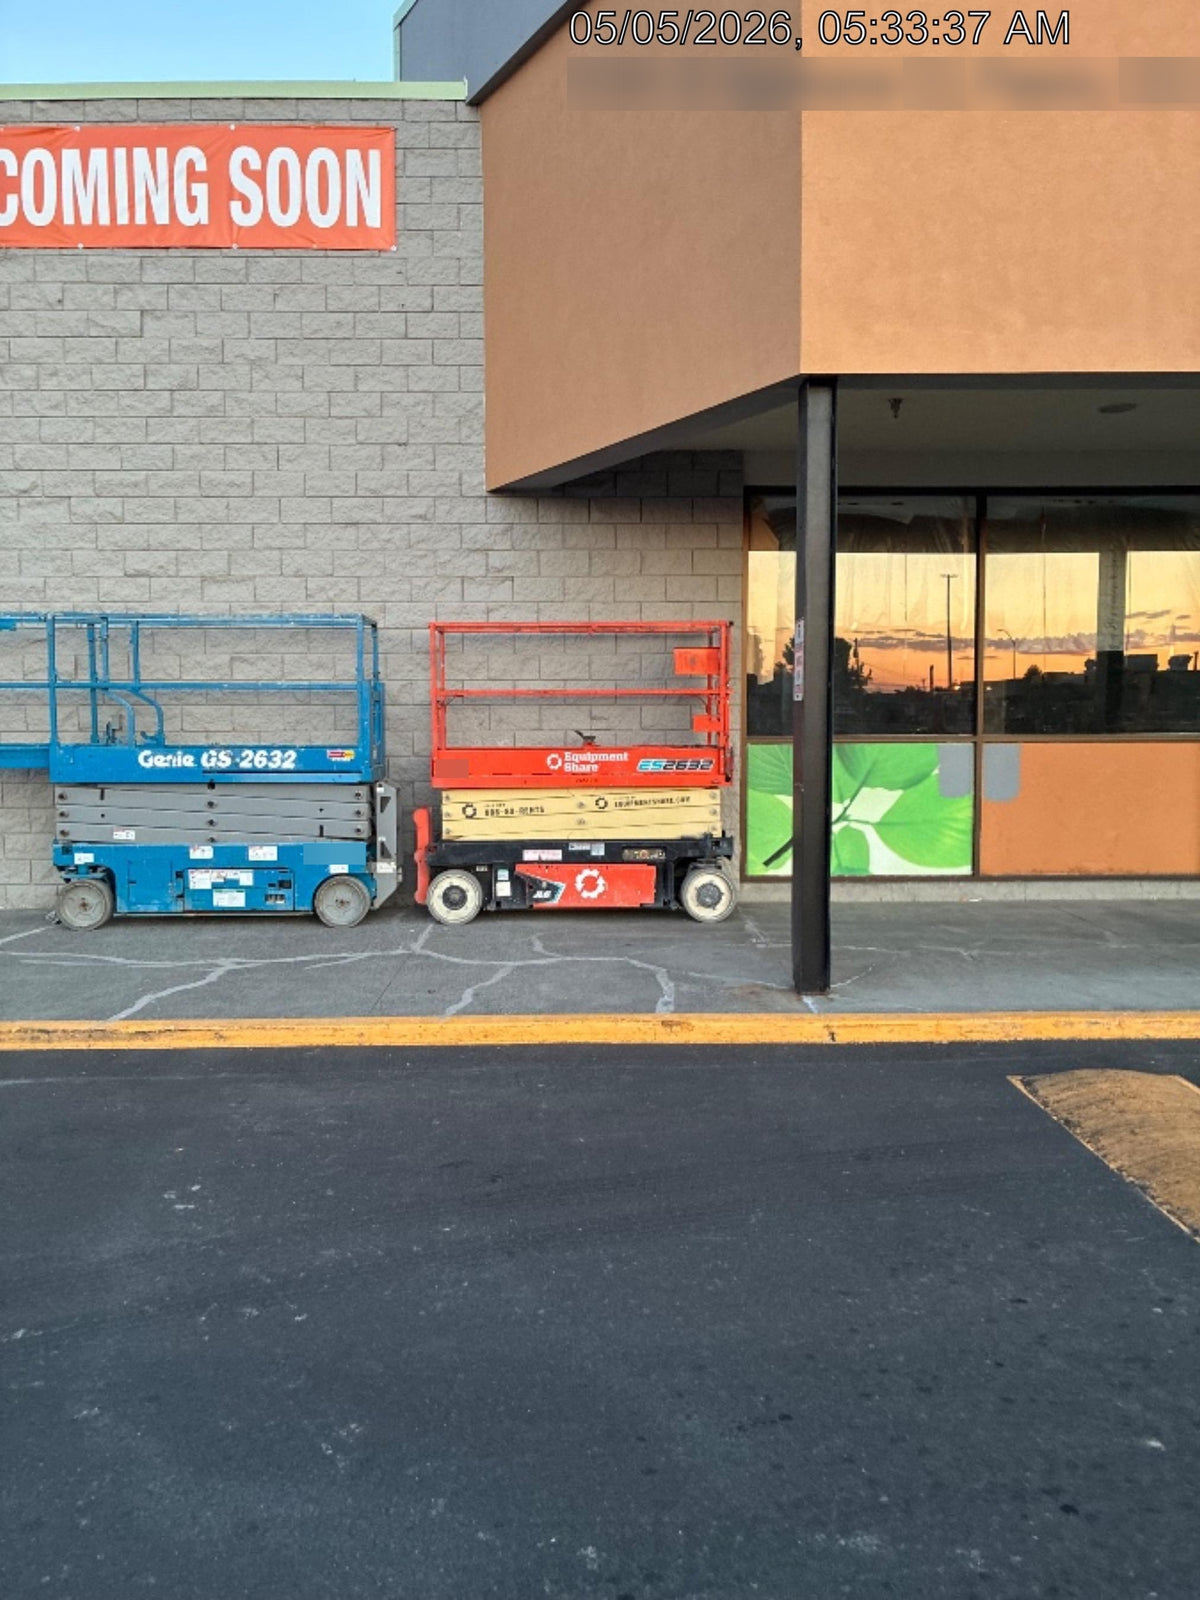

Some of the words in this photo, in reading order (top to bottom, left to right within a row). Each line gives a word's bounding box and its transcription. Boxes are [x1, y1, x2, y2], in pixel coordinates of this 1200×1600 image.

[229, 146, 381, 228] SOON
[138, 750, 197, 768] Genie
[564, 751, 629, 763] Equipment
[564, 762, 598, 772] Share
[638, 759, 714, 771] ES2632
